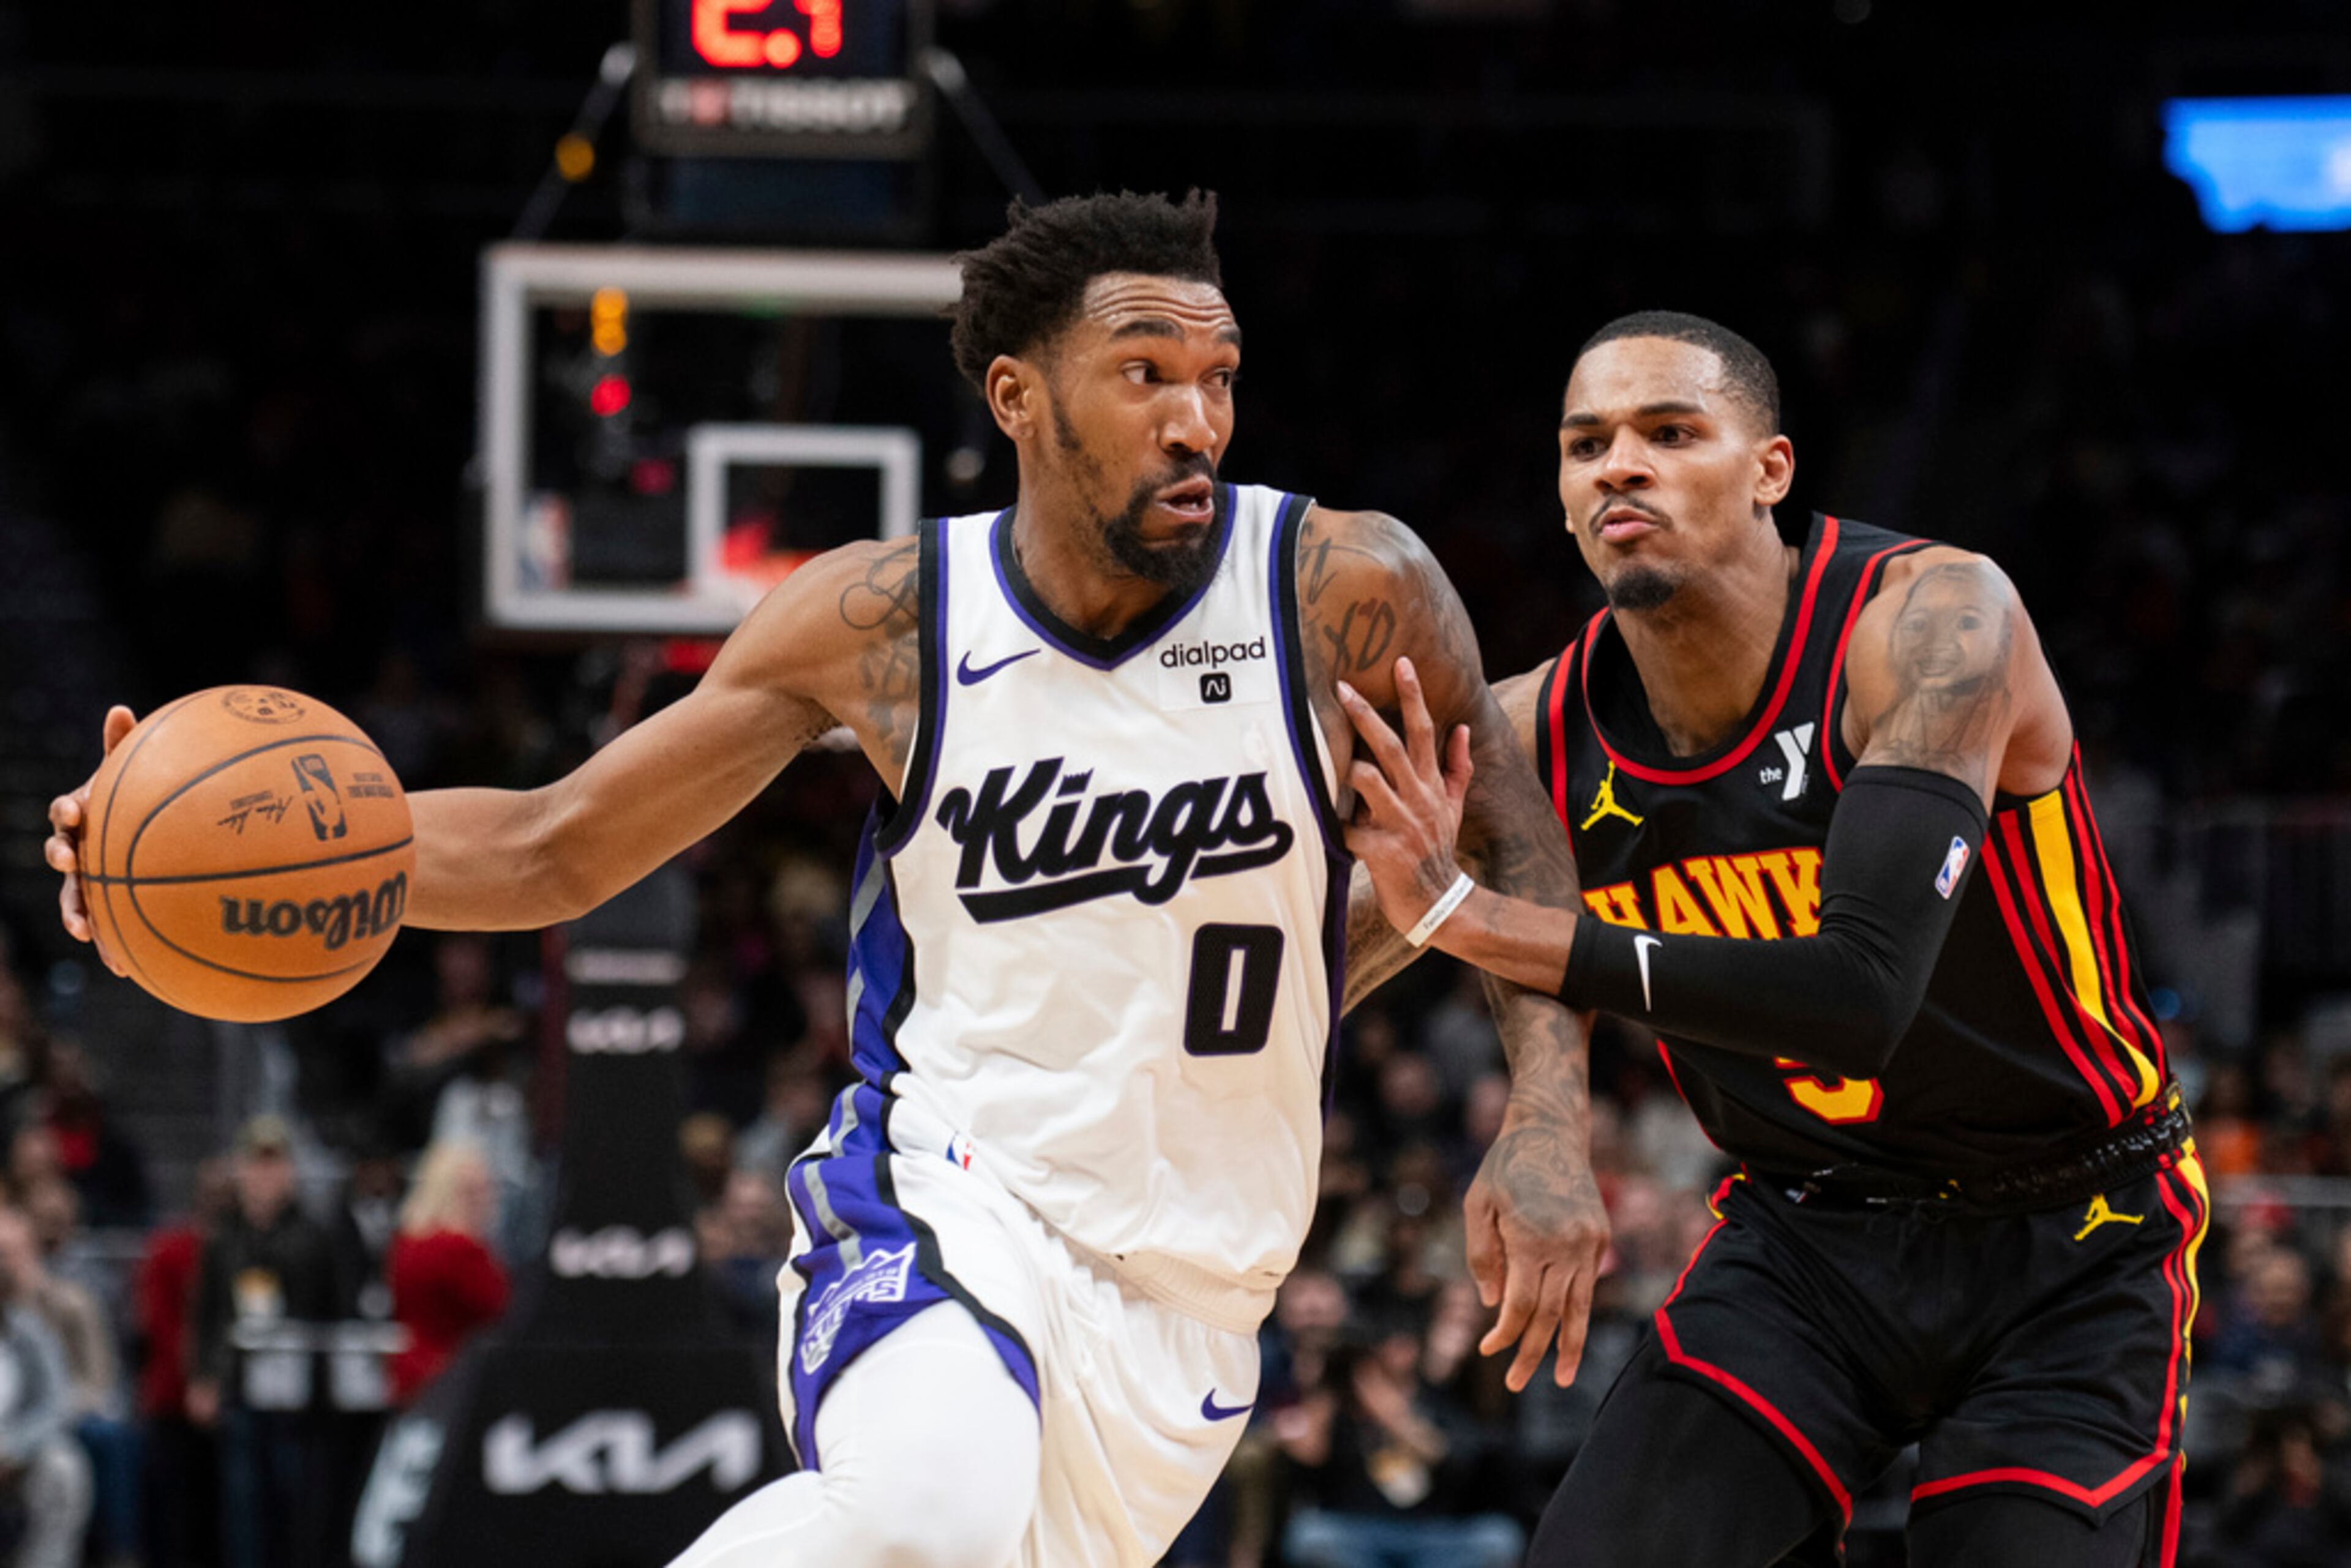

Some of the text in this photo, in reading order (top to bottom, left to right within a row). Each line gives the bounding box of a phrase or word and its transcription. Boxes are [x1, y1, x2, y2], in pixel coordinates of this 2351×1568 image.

[1160, 636, 1265, 669] dialpad
[1760, 767, 1783, 784] the
[935, 757, 1294, 925] Kings
[220, 871, 407, 950] Wilson
[1184, 923, 1286, 1057] 0
